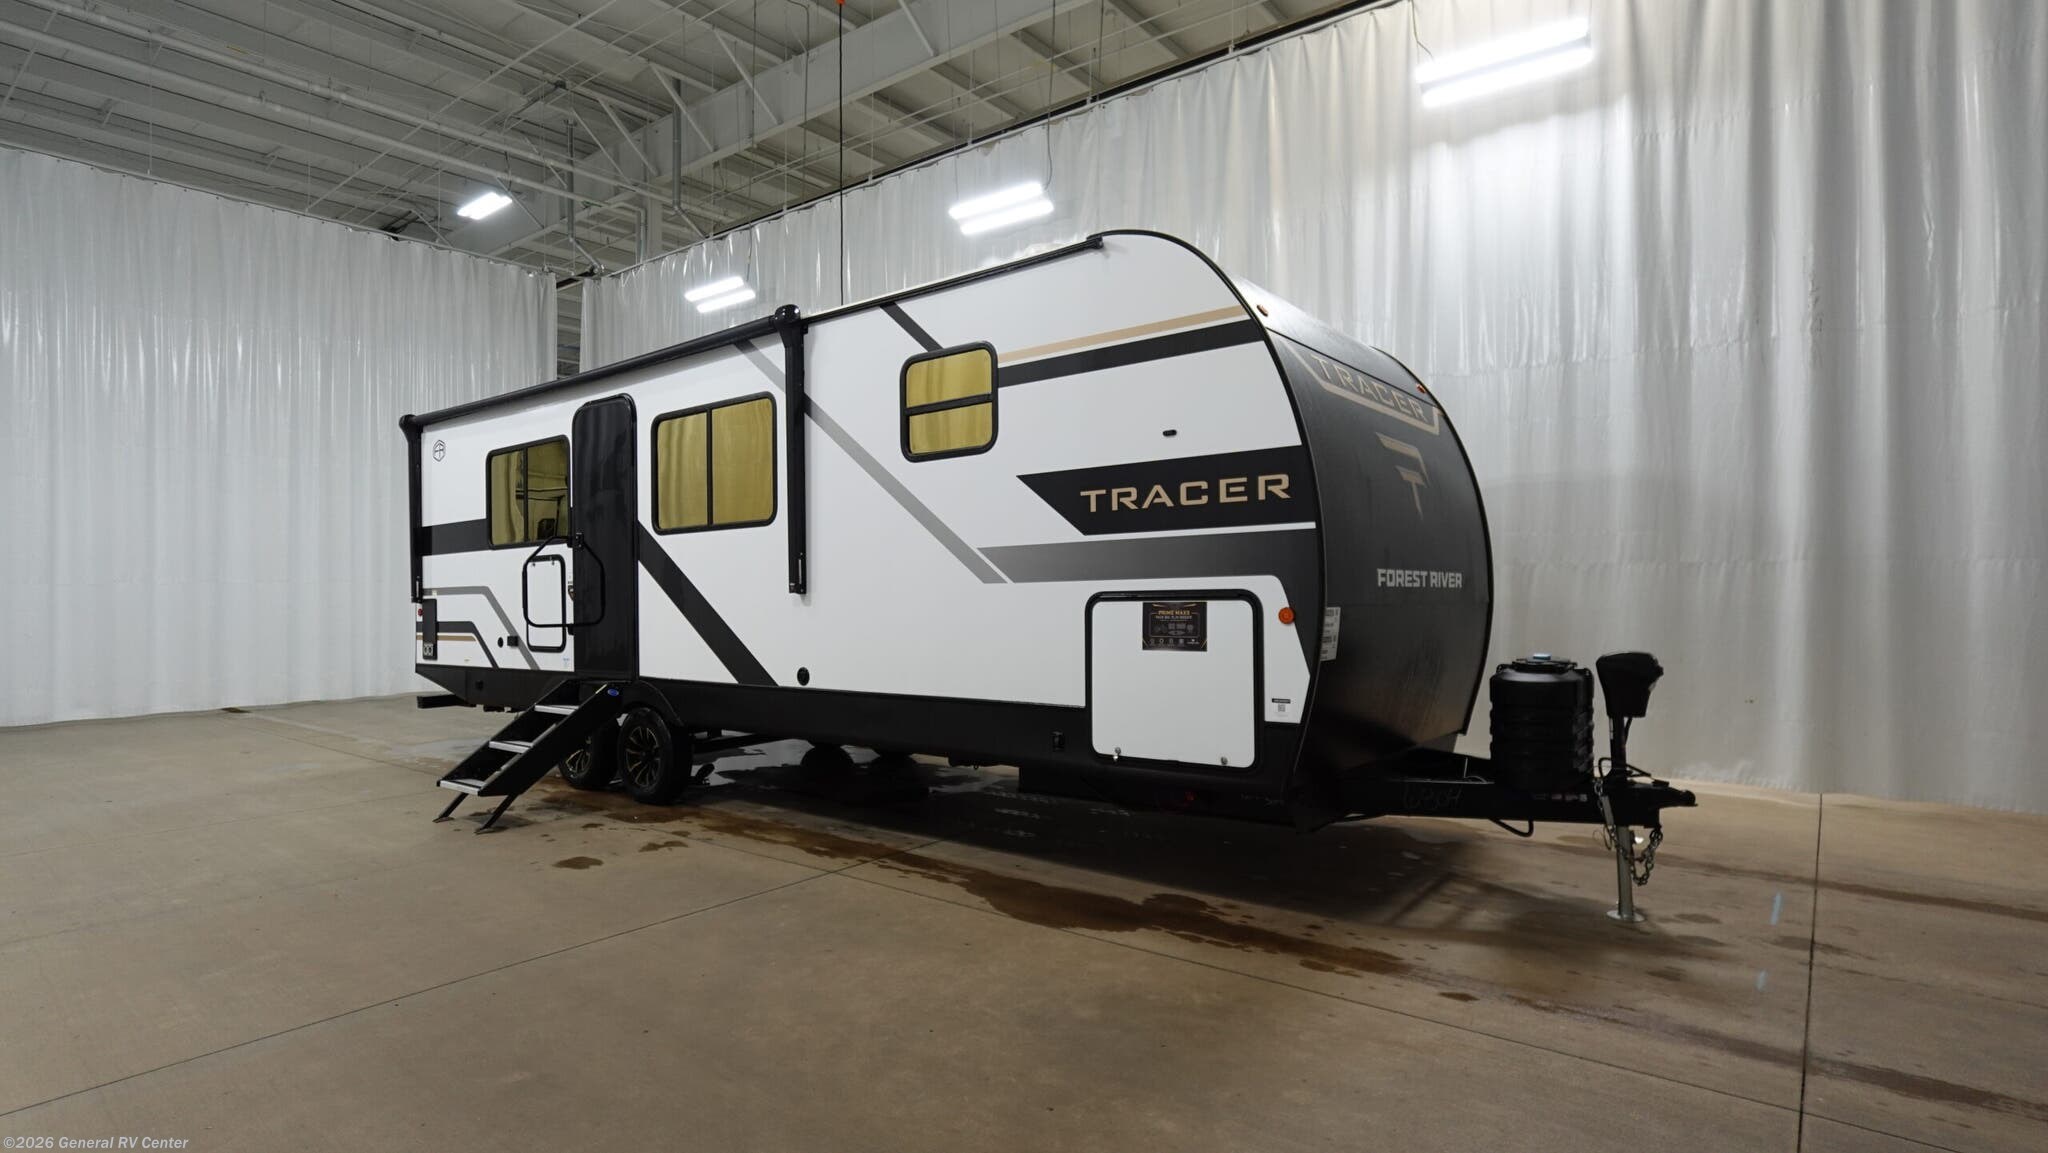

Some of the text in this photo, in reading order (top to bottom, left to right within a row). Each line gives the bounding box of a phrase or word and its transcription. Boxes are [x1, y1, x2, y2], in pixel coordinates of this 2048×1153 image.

[1311, 356, 1425, 419] TRACER
[1079, 472, 1291, 513] TRACER
[1376, 568, 1463, 588] FOREST RIVER
